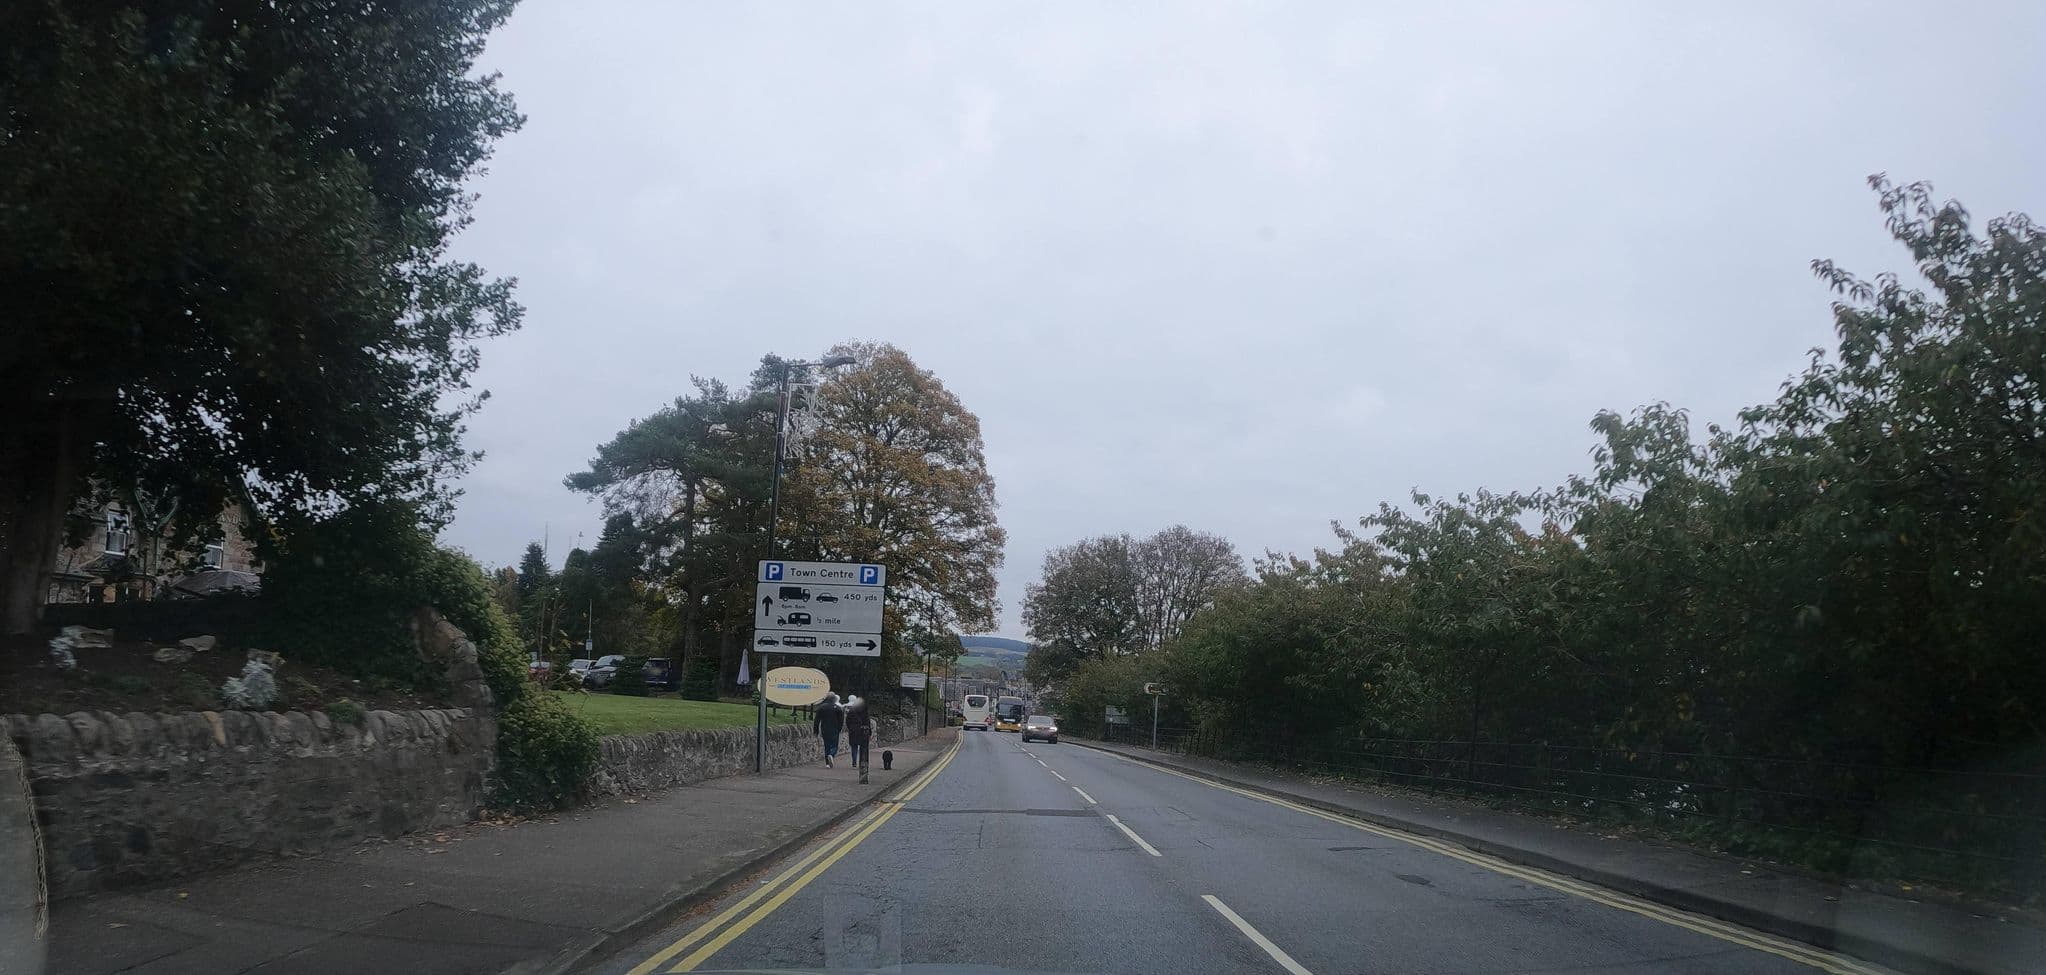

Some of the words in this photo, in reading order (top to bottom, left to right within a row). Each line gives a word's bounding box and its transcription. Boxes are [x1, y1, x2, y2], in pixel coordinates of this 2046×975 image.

[769, 564, 780, 579] P
[790, 567, 816, 577] Town
[820, 568, 854, 579] Centre
[863, 568, 875, 582] P
[844, 593, 861, 601] 450
[864, 593, 878, 602] yds
[824, 617, 841, 625] mile
[821, 639, 836, 647] 150
[839, 640, 852, 648] yds
